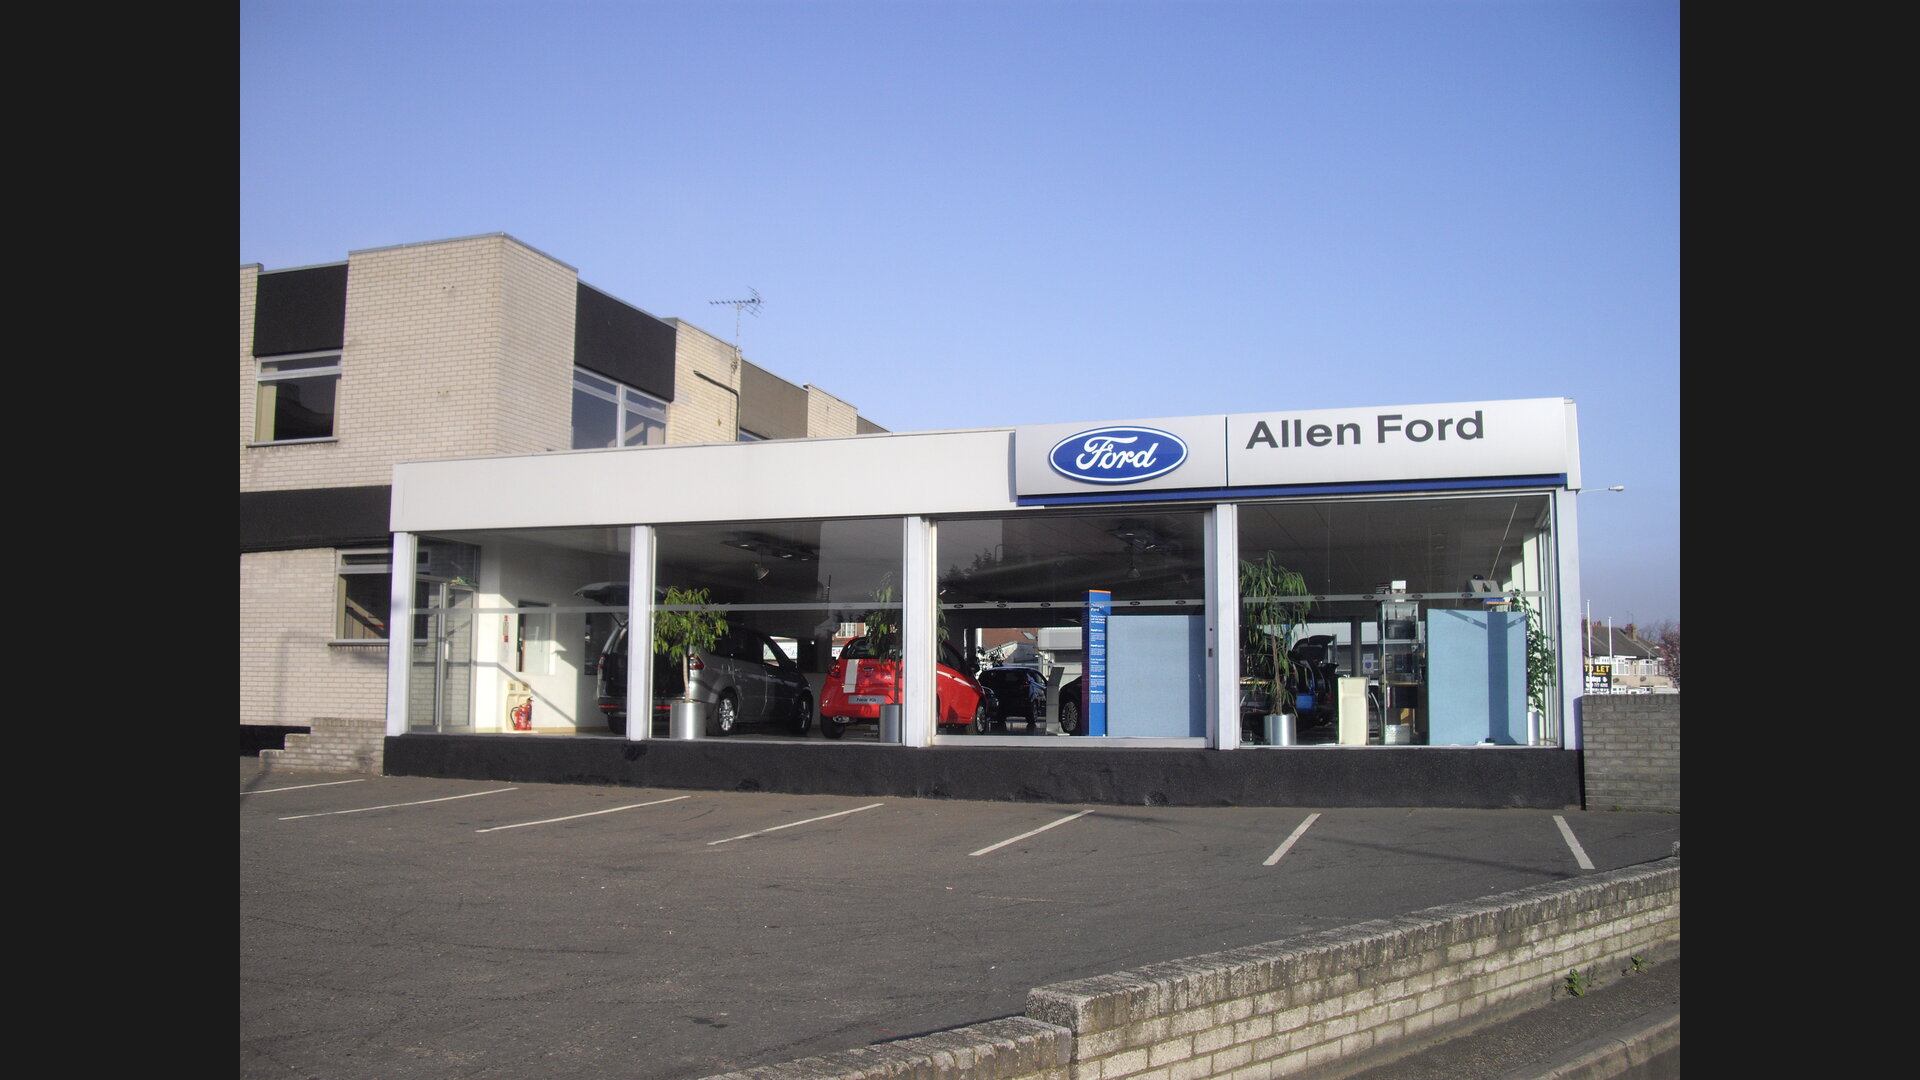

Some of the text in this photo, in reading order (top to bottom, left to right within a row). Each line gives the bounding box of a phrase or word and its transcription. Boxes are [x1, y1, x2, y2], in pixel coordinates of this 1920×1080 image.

[1245, 410, 1484, 450] Allen Ford
[1076, 436, 1158, 471] Ford
